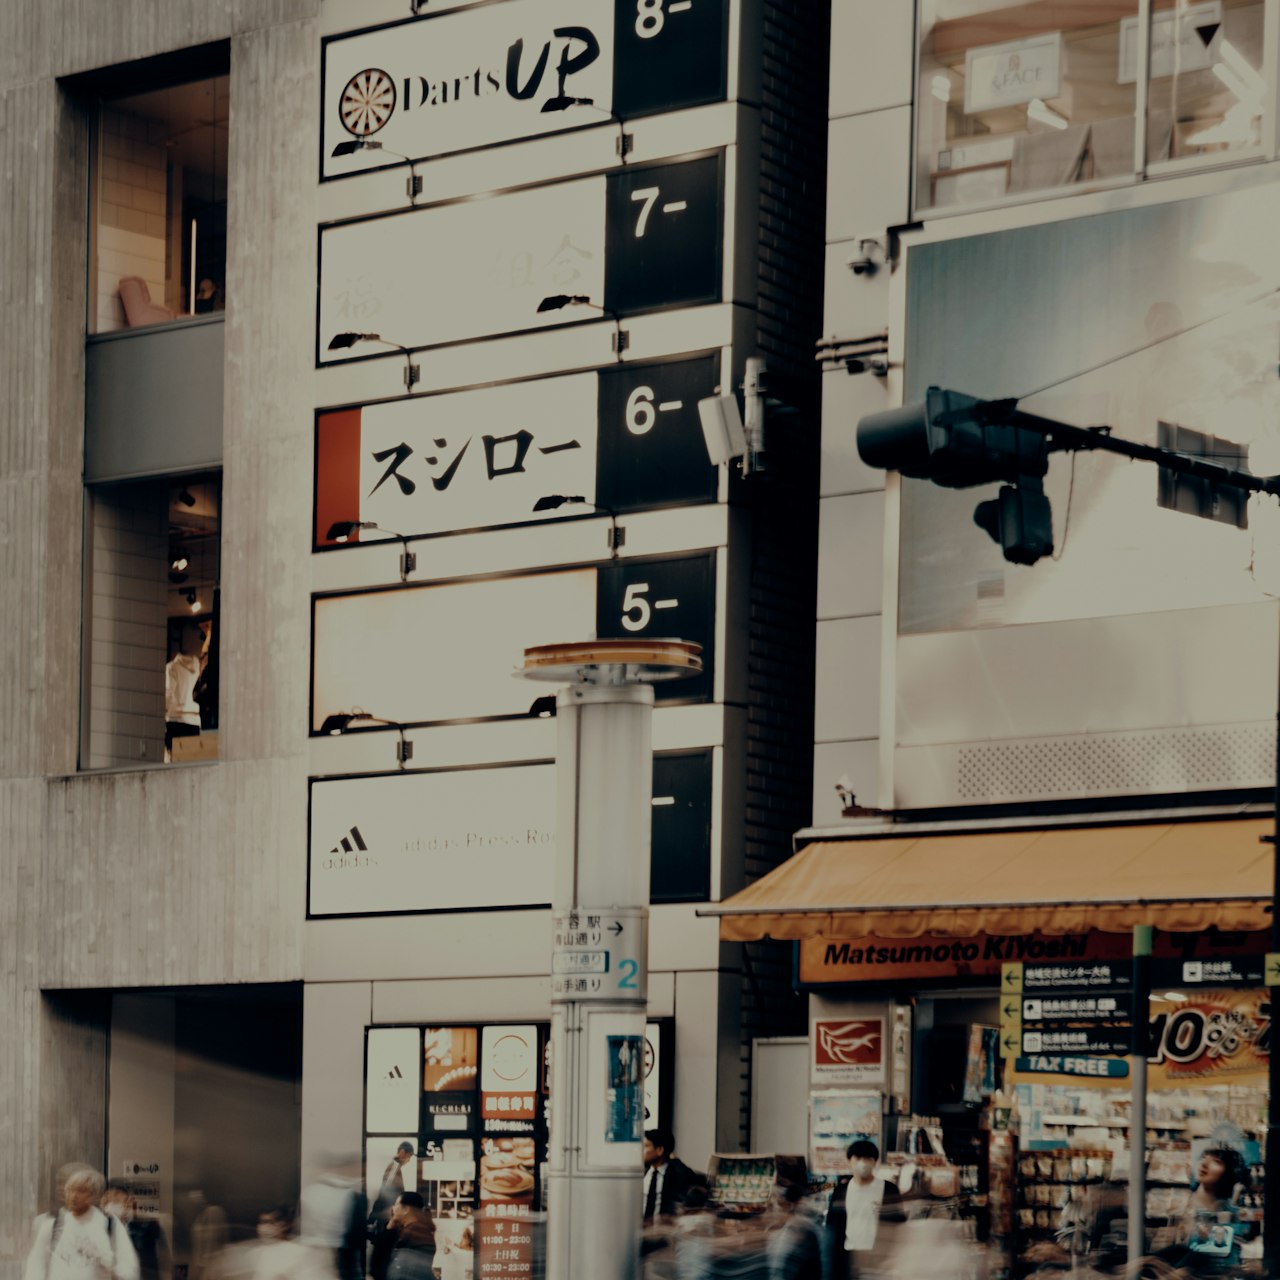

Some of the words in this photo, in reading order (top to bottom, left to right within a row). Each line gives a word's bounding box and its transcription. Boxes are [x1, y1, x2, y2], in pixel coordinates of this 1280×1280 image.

[403, 66, 500, 112] Darts
[506, 26, 600, 100] UP
[368, 429, 582, 498] スシロー
[824, 941, 979, 965] Matsumoto
[617, 959, 640, 988] 2
[1028, 1054, 1061, 1072] TAX
[1064, 1058, 1110, 1076] FREE
